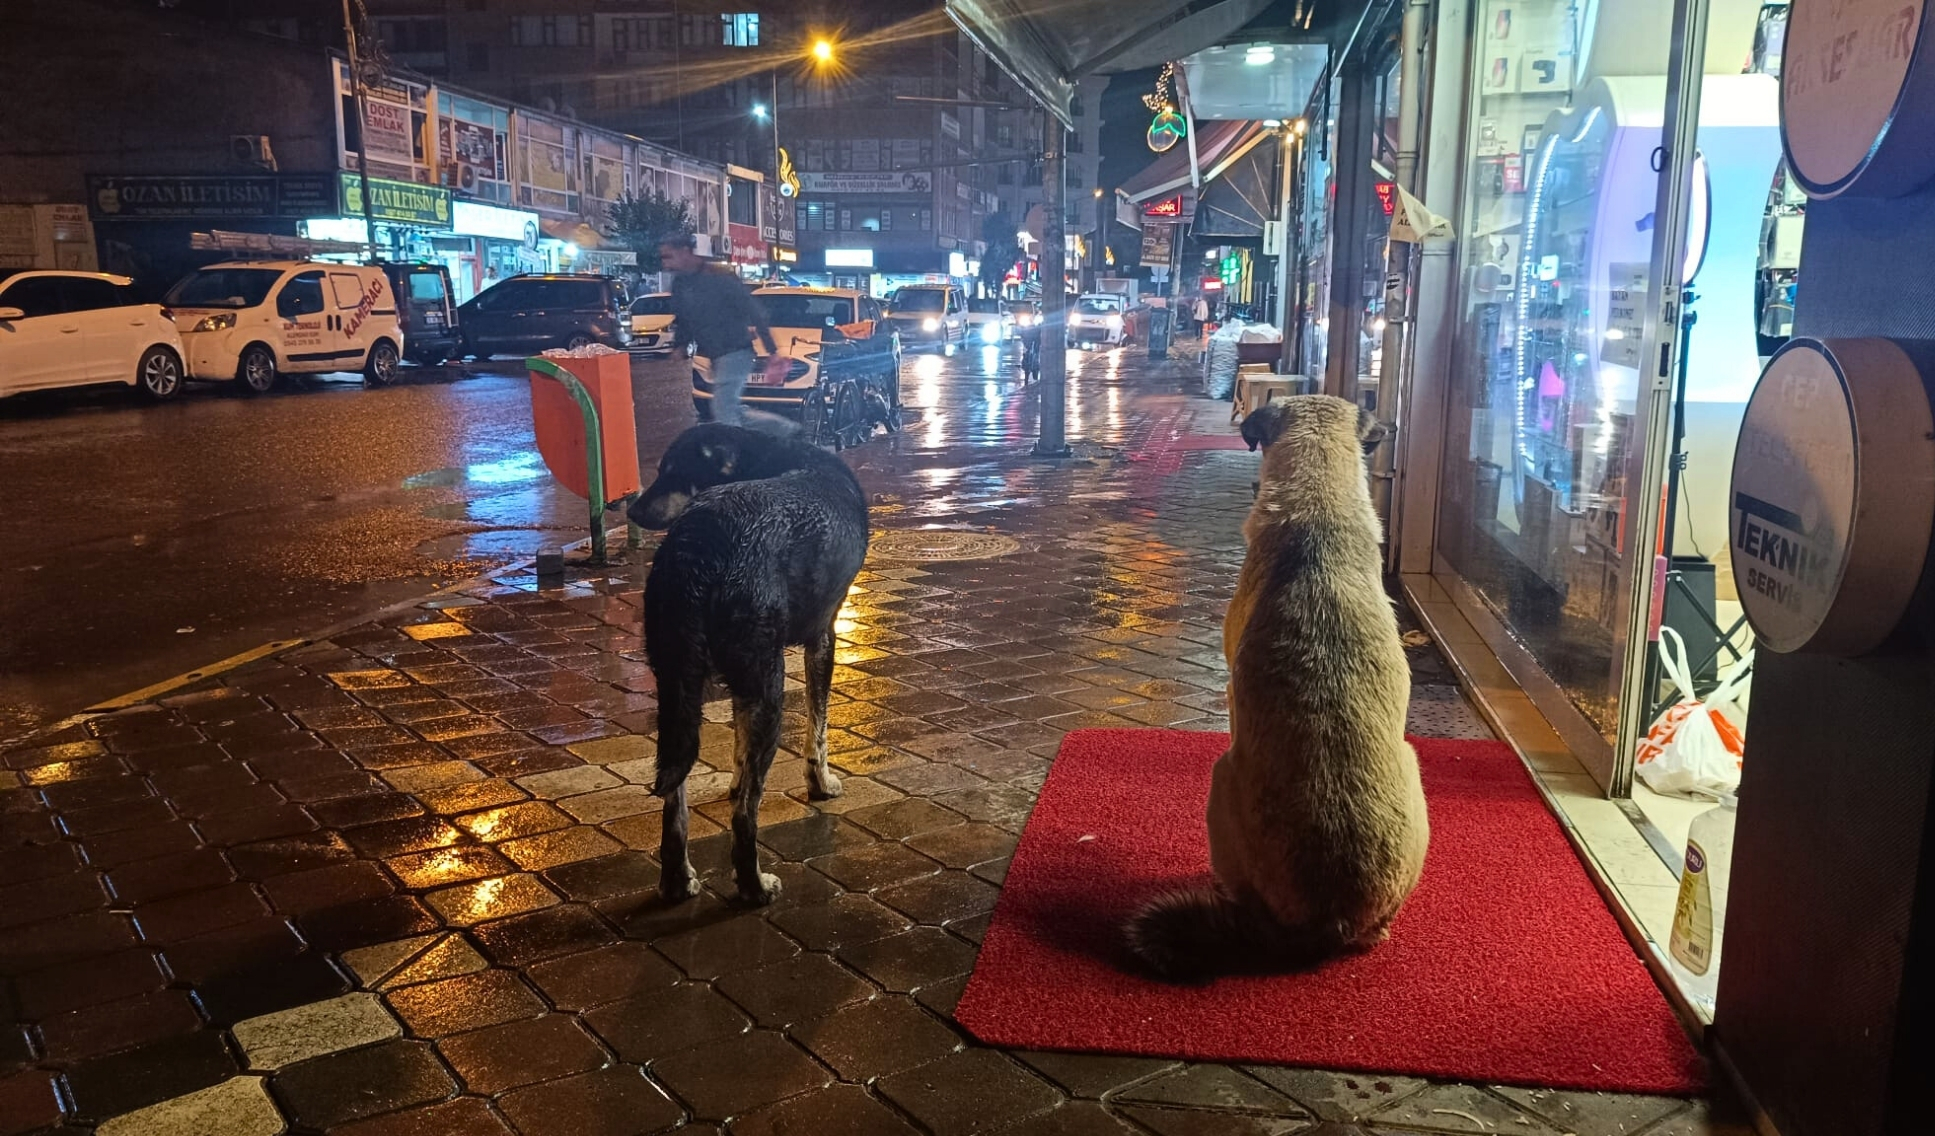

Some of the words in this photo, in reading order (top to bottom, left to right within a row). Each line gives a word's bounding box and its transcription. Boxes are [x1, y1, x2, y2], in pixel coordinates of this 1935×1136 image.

[370, 103, 399, 118] DOST
[366, 115, 404, 133] EMLAK
[122, 185, 177, 203] OZAN
[369, 187, 393, 208] ZAN
[343, 278, 385, 340] KAMERACI
